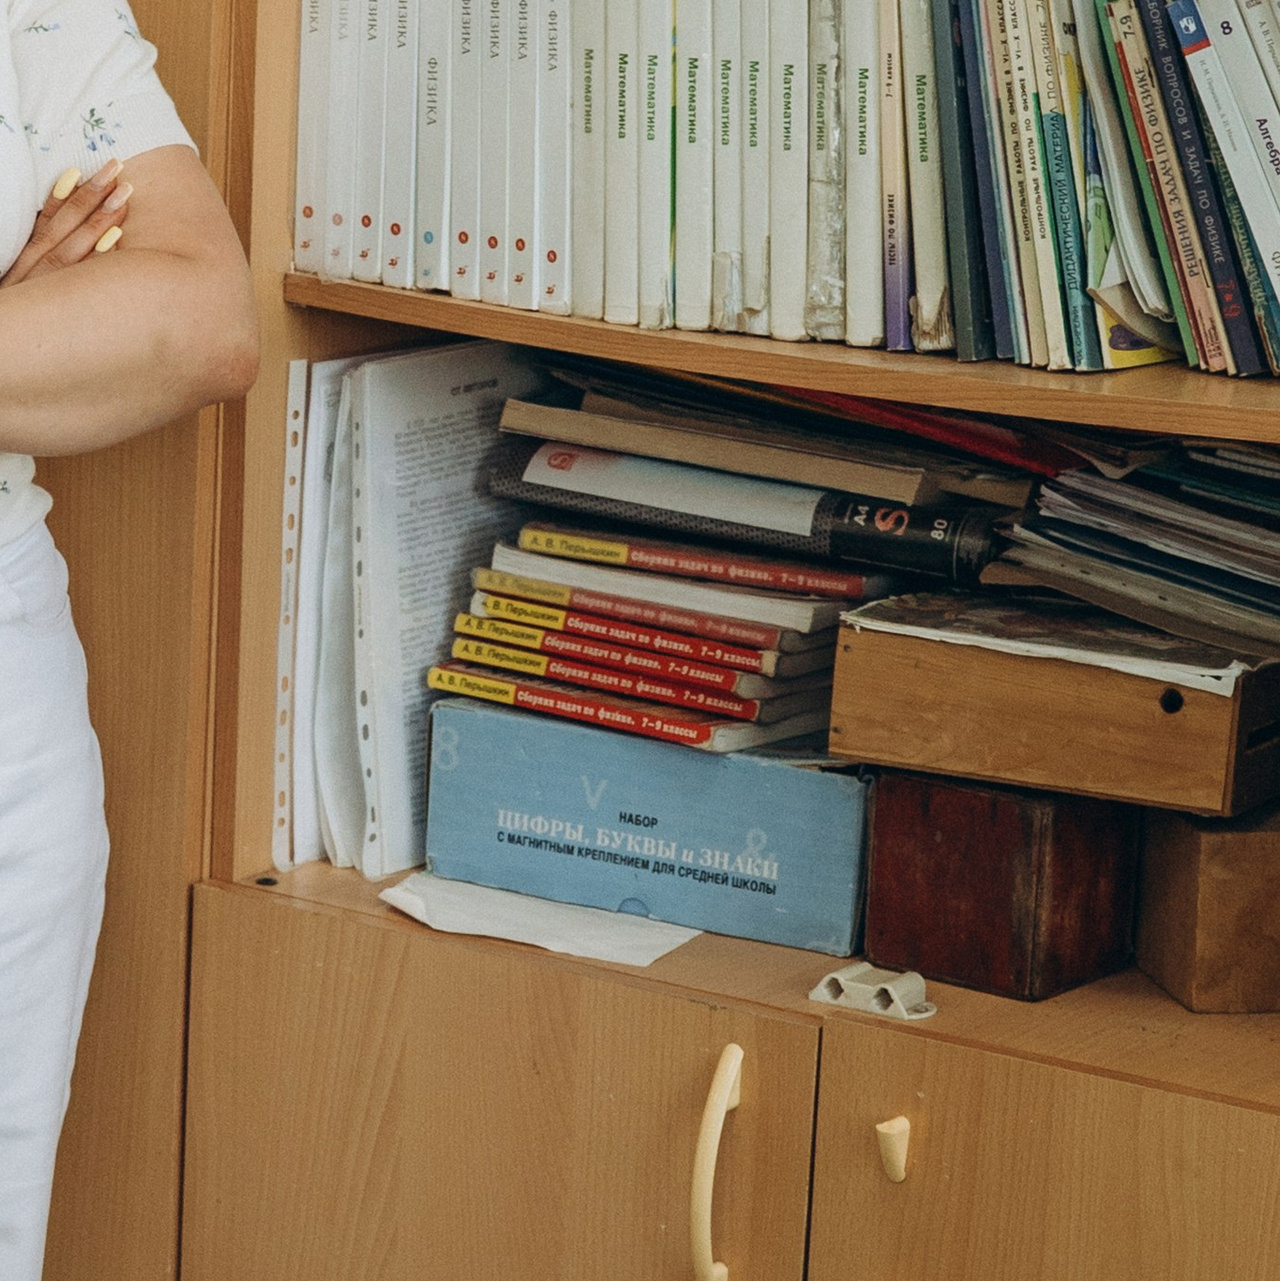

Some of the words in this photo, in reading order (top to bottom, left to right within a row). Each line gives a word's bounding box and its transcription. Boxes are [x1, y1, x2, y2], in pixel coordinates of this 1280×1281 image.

[518, 0, 528, 60] ФИЗИКА
[548, 10, 558, 71] ФИЗИКА
[1040, 21, 1053, 77] ФИЗИКЕ
[1220, 20, 1233, 36] 8
[427, 57, 438, 125] ФИЗИКА
[584, 48, 594, 134] Математика
[618, 53, 628, 139] Математика
[646, 54, 658, 141] Математика
[688, 57, 698, 144] Математика
[721, 59, 731, 146] Математика
[749, 61, 759, 148] Математика
[783, 64, 794, 151] Математика
[858, 67, 869, 156] Математика
[1005, 82, 1016, 116] ФИЗИКЕ
[1019, 78, 1029, 112] ФИЗИКЕ
[1046, 80, 1057, 99] ПО
[1134, 68, 1158, 127] ФИЗИКЕ
[1161, 55, 1188, 125] ВОПРОСОВ
[915, 74, 929, 163] Математика
[1011, 122, 1018, 135] ПО
[1024, 118, 1032, 131] ПО
[1050, 106, 1064, 174] МАТЕРИАЛ
[1181, 130, 1192, 140] И
[1013, 140, 1023, 174] РАБОТЫ
[1027, 137, 1038, 171] РАБОТЫ
[1152, 131, 1167, 155] ПО
[1185, 146, 1203, 184] ЗАДАЧ
[1256, 118, 1280, 176] Алгебра
[1160, 160, 1181, 205] ЗАДАЧ
[1197, 190, 1210, 209] ПО
[887, 194, 895, 225] ФИЗИКЕ
[1032, 178, 1046, 239] КОНТРОЛЬНЫЕ
[888, 227, 896, 239] ПО
[888, 242, 896, 266] ТЕСТЫ
[1055, 179, 1079, 291] ДИДАКТИЧЕСКИЙ
[1172, 209, 1200, 277] РЕШЕНИЯ
[1204, 215, 1226, 264] ФИЗИКЕ
[853, 505, 870, 526] A4
[930, 518, 948, 540] 80
[631, 551, 676, 567] Сборник
[710, 564, 723, 573] по
[488, 622, 537, 642] Перышкин
[505, 603, 559, 623] Перышкин
[488, 648, 542, 668] Перышкин
[545, 636, 582, 652] Сборник
[583, 646, 609, 658] задач
[610, 652, 621, 660] по
[689, 669, 724, 683] классы
[567, 617, 608, 635] Сборник
[609, 628, 637, 641] задач
[638, 635, 650, 644] по
[654, 636, 693, 653] физике.
[723, 653, 761, 667] классы
[460, 677, 510, 698] Перышкин
[549, 662, 589, 679] Сборник
[590, 673, 618, 686] задач
[620, 679, 633, 688] по
[705, 697, 743, 711] классы
[517, 691, 555, 707] Сборник
[556, 701, 582, 713] задач
[583, 706, 595, 716] по
[662, 724, 698, 738] классы
[436, 726, 459, 771] 8
[619, 811, 658, 829] НАБОР
[497, 808, 590, 846] ЦИФРЫ,
[596, 827, 676, 860] БУКВЫ
[681, 851, 694, 863] и
[699, 847, 779, 880] ЗНАКИ
[497, 831, 504, 842] С
[507, 834, 575, 855] МАГНИТНЫМ
[577, 847, 650, 870] КРЕПЛЕНИЕМ
[652, 861, 675, 875] ДЛЯ
[678, 866, 729, 886] СРЕДНЕЙ
[731, 876, 777, 895] ШКОЛЫ
